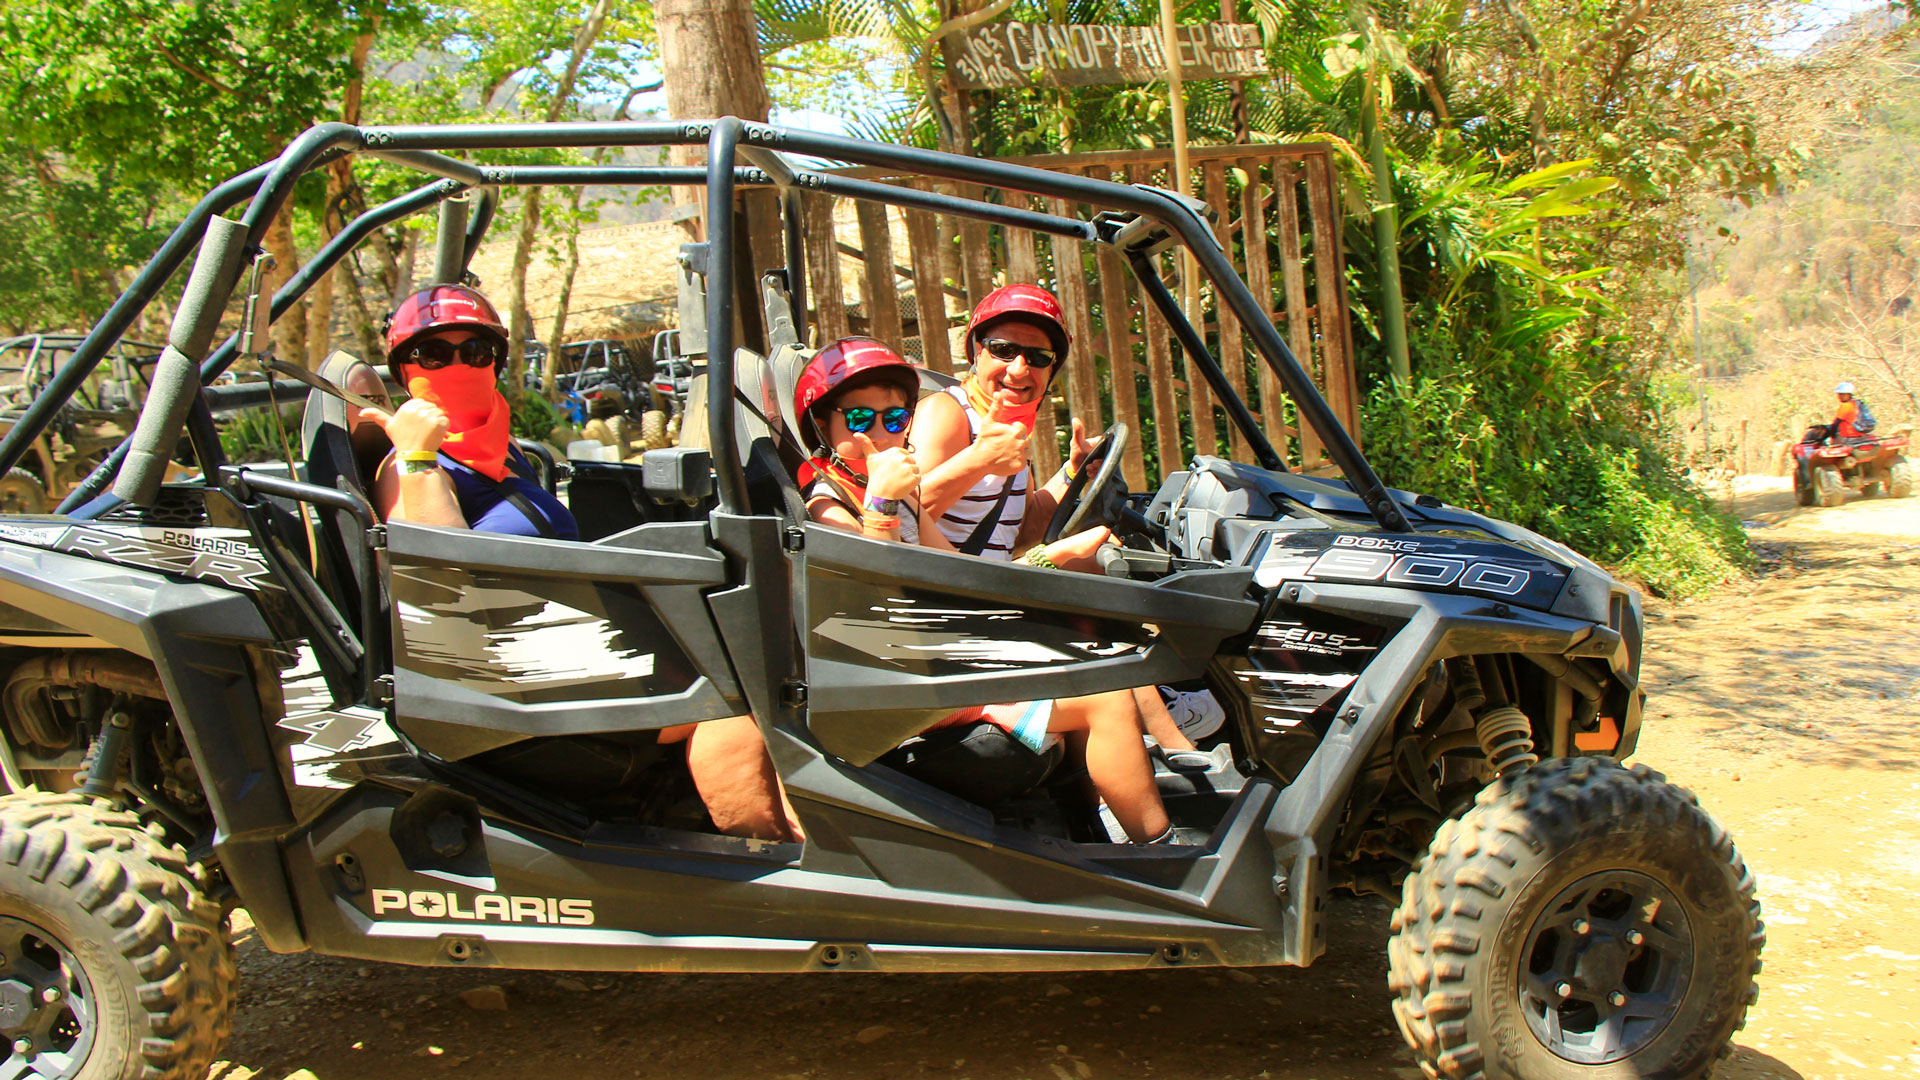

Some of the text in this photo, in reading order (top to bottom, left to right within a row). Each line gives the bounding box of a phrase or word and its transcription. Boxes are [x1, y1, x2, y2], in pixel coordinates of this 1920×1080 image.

[53, 524, 270, 591] RZR
[162, 529, 249, 557] POLARIS
[1333, 534, 1420, 552] DOHC
[1303, 548, 1531, 596] 900
[1284, 627, 1348, 647] EPS
[275, 710, 382, 753] 4
[371, 888, 596, 927] POLARIS
